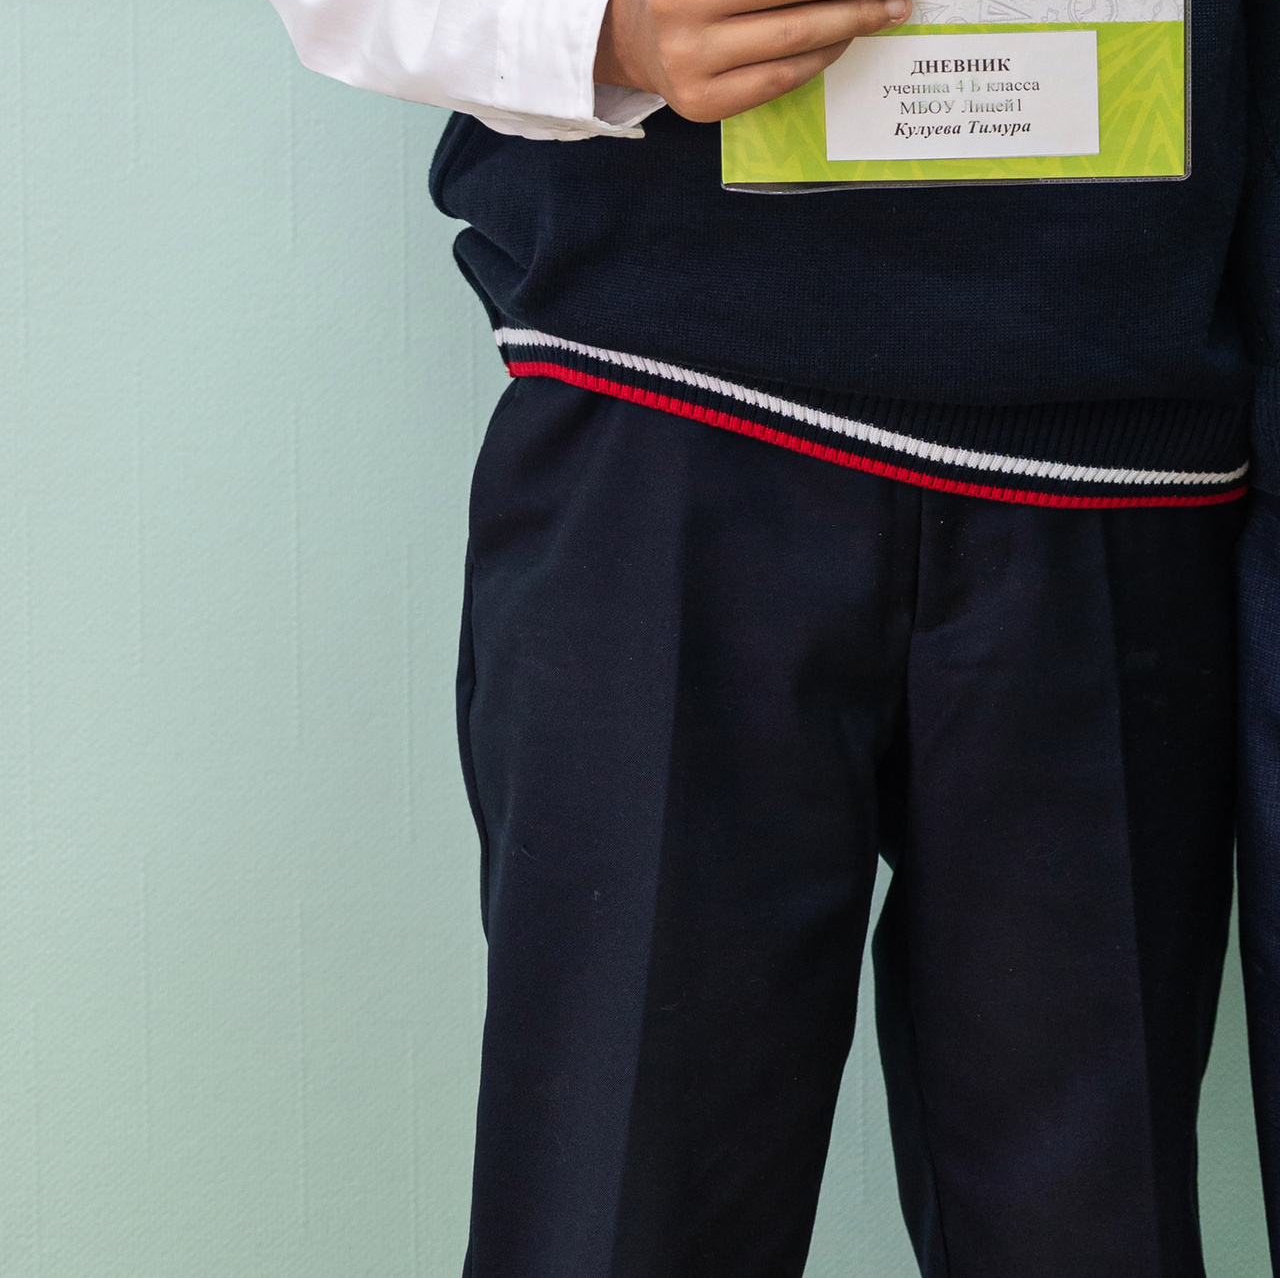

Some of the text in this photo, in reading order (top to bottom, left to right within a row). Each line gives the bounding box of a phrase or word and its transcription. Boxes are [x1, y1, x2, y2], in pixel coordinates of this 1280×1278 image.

[911, 58, 1011, 76] ДНЕВНИК
[883, 82, 950, 99] ученика
[955, 79, 965, 93] 4
[986, 80, 1041, 93] класса
[900, 100, 956, 115] МБОУ
[894, 120, 1032, 139] Кулуева Тимура
